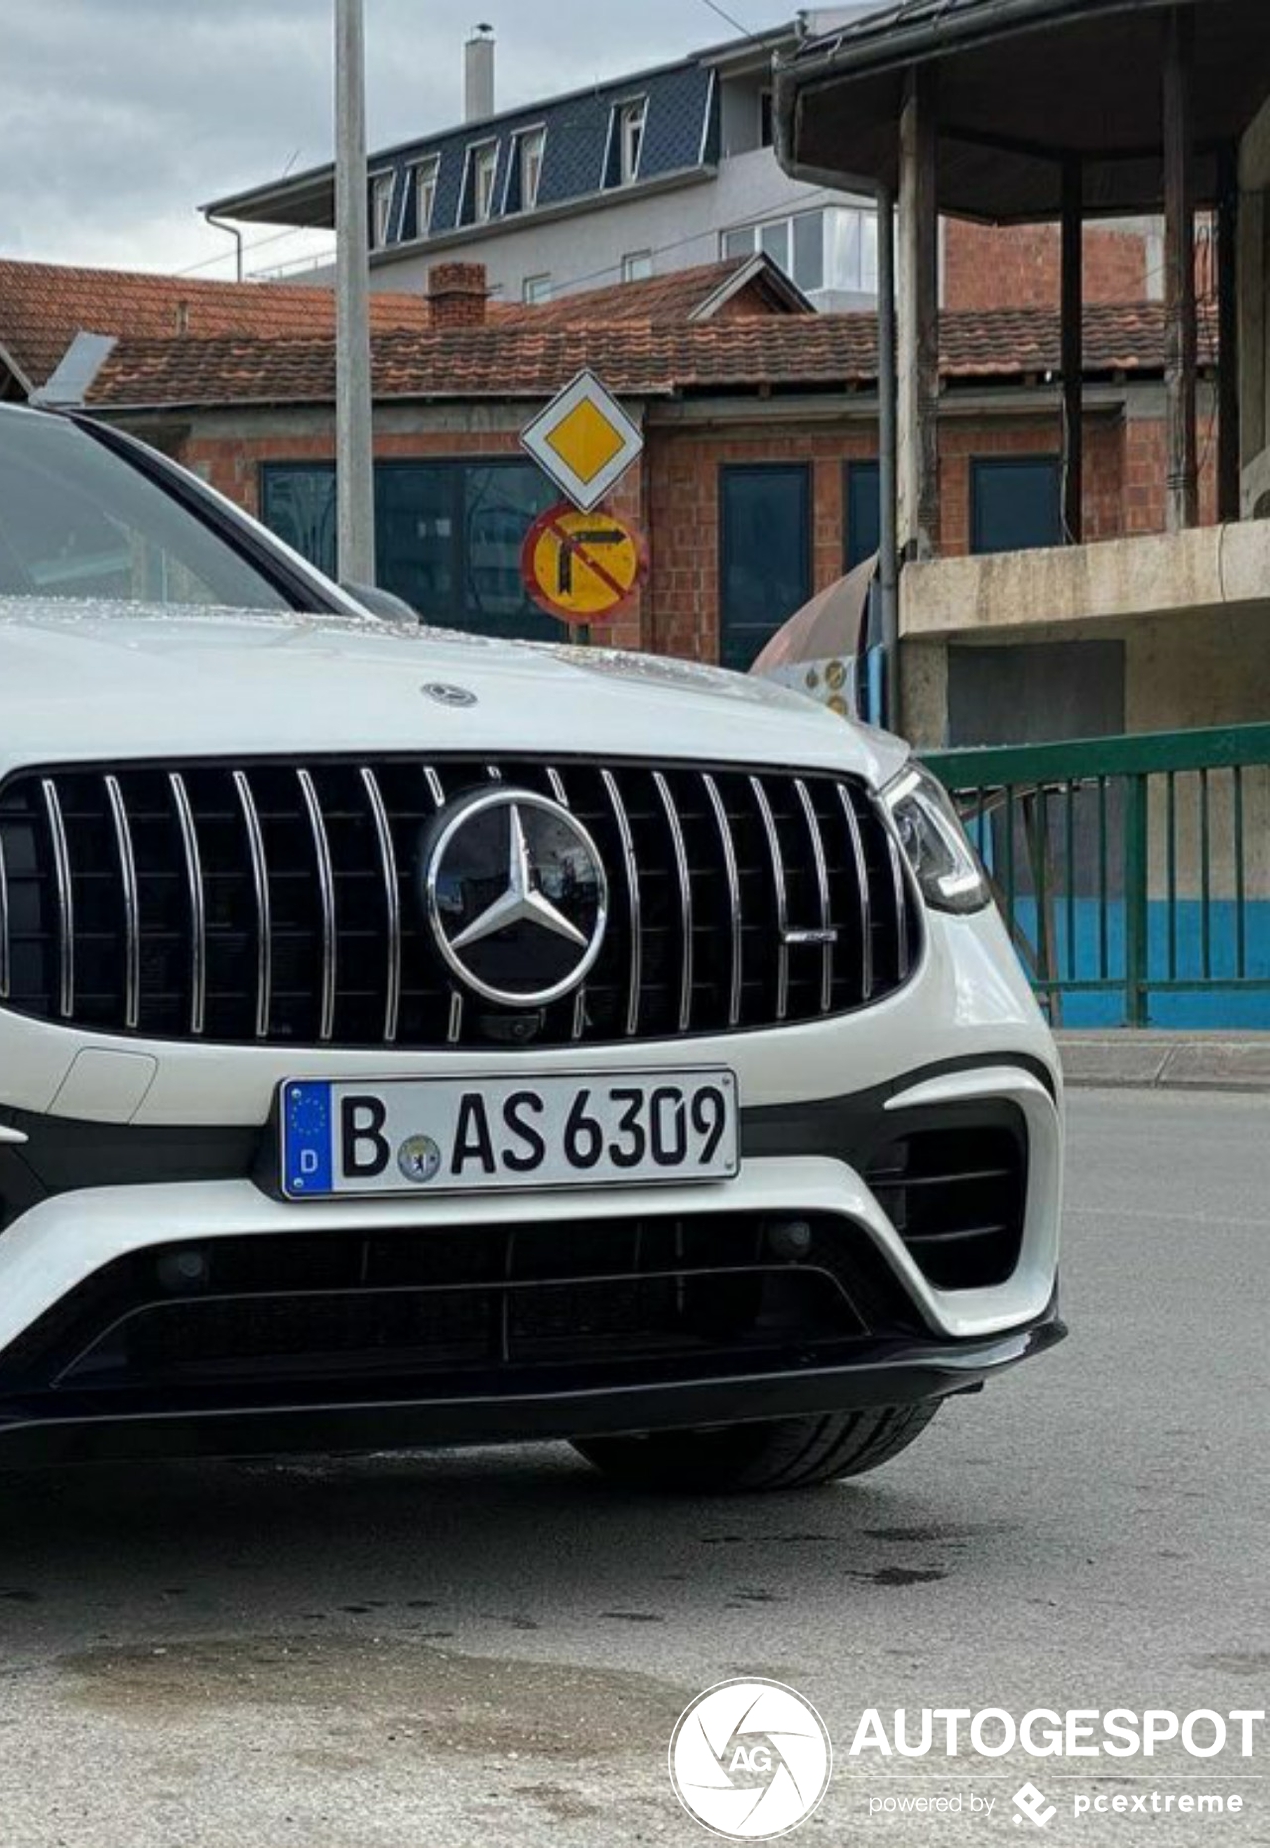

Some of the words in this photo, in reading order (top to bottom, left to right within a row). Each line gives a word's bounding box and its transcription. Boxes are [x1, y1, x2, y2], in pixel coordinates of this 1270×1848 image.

[300, 1149, 318, 1173] D
[341, 1095, 390, 1178] B
[451, 1091, 546, 1174] AS
[563, 1086, 726, 1169] 6309
